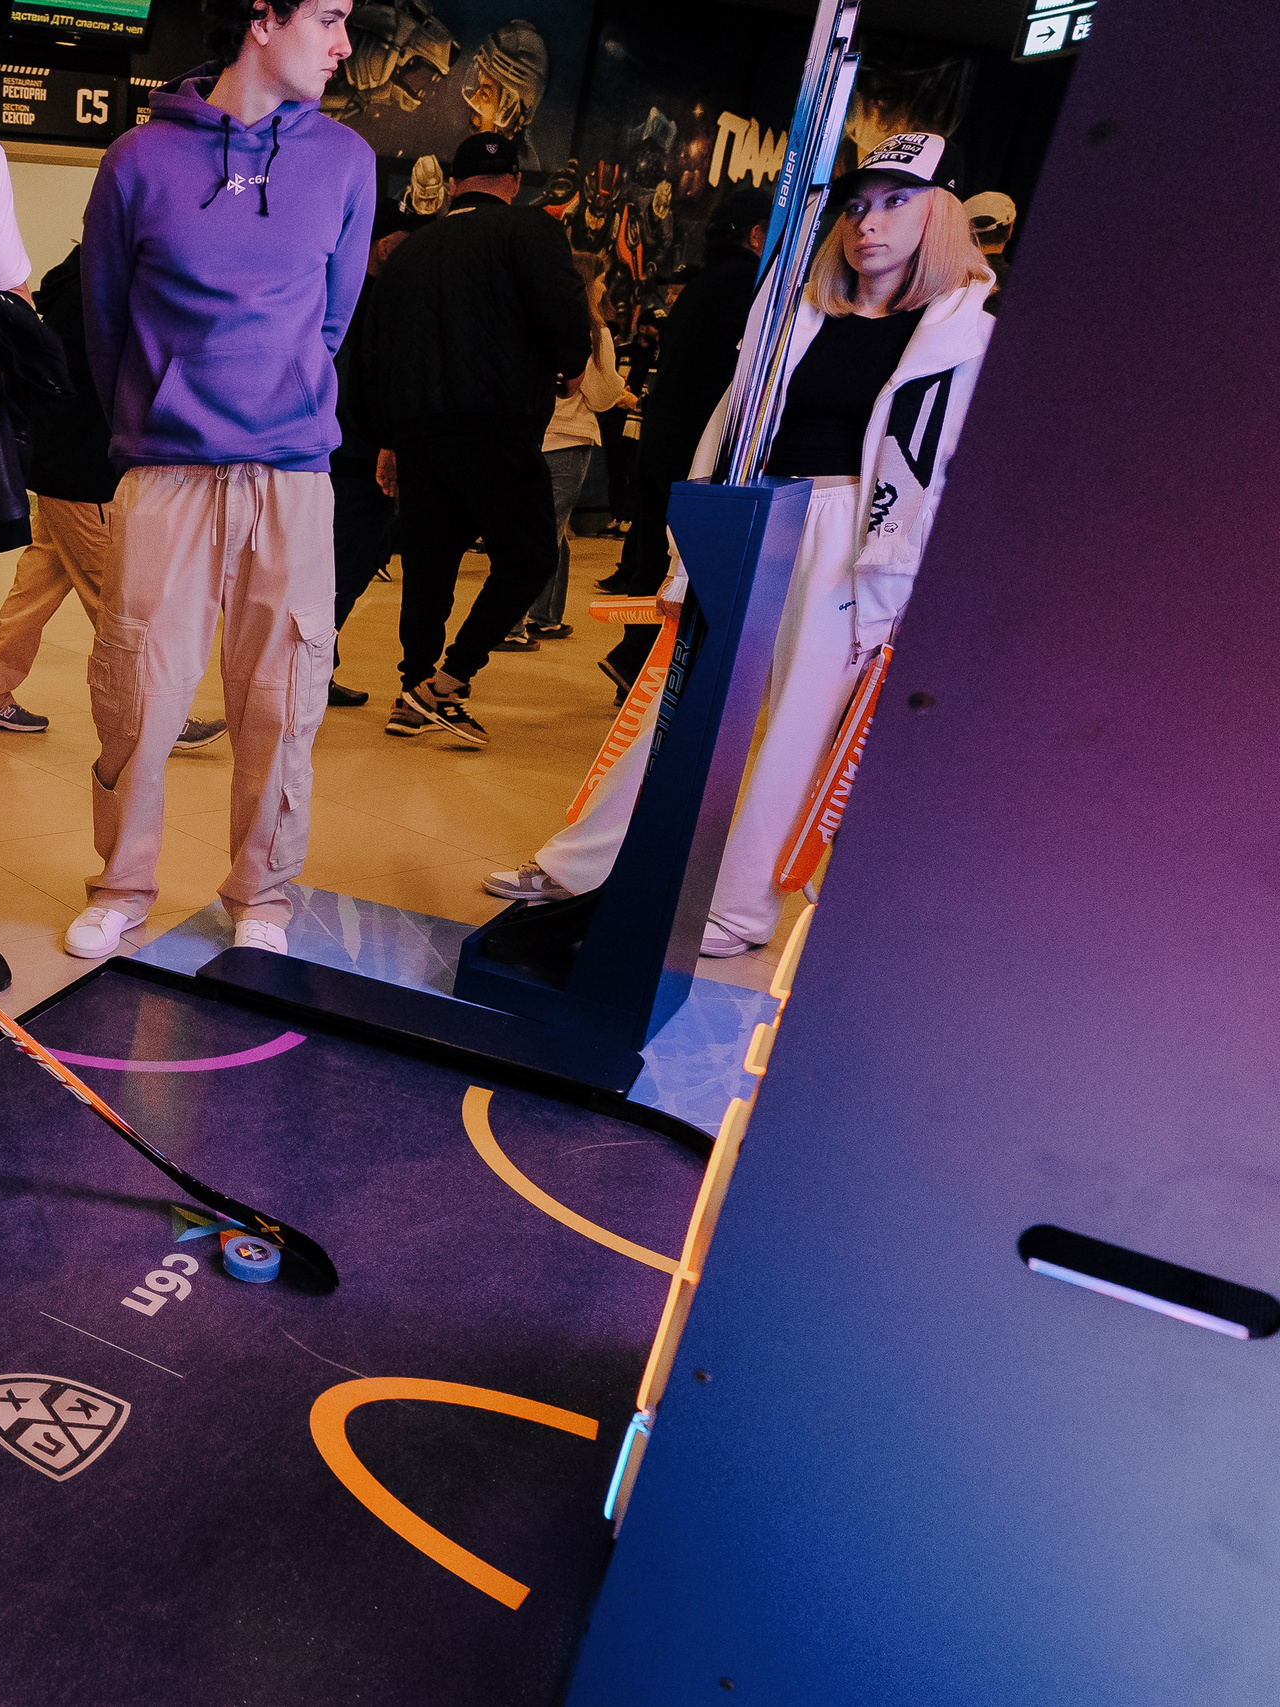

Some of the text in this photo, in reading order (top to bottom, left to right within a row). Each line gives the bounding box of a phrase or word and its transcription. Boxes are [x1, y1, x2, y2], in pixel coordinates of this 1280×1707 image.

[50, 14, 74, 26] ДТП
[75, 19, 110, 30] спасли
[112, 22, 124, 32] 34
[126, 25, 143, 34] чел
[3, 77, 43, 86] RESTAURANT
[3, 85, 47, 101] РЕСТОРАН
[3, 103, 30, 111] SECTION
[2, 111, 35, 125] СЕКТОР
[901, 144, 921, 153] 1947
[777, 151, 798, 208] BAUER
[120, 1253, 199, 1317] сбп
